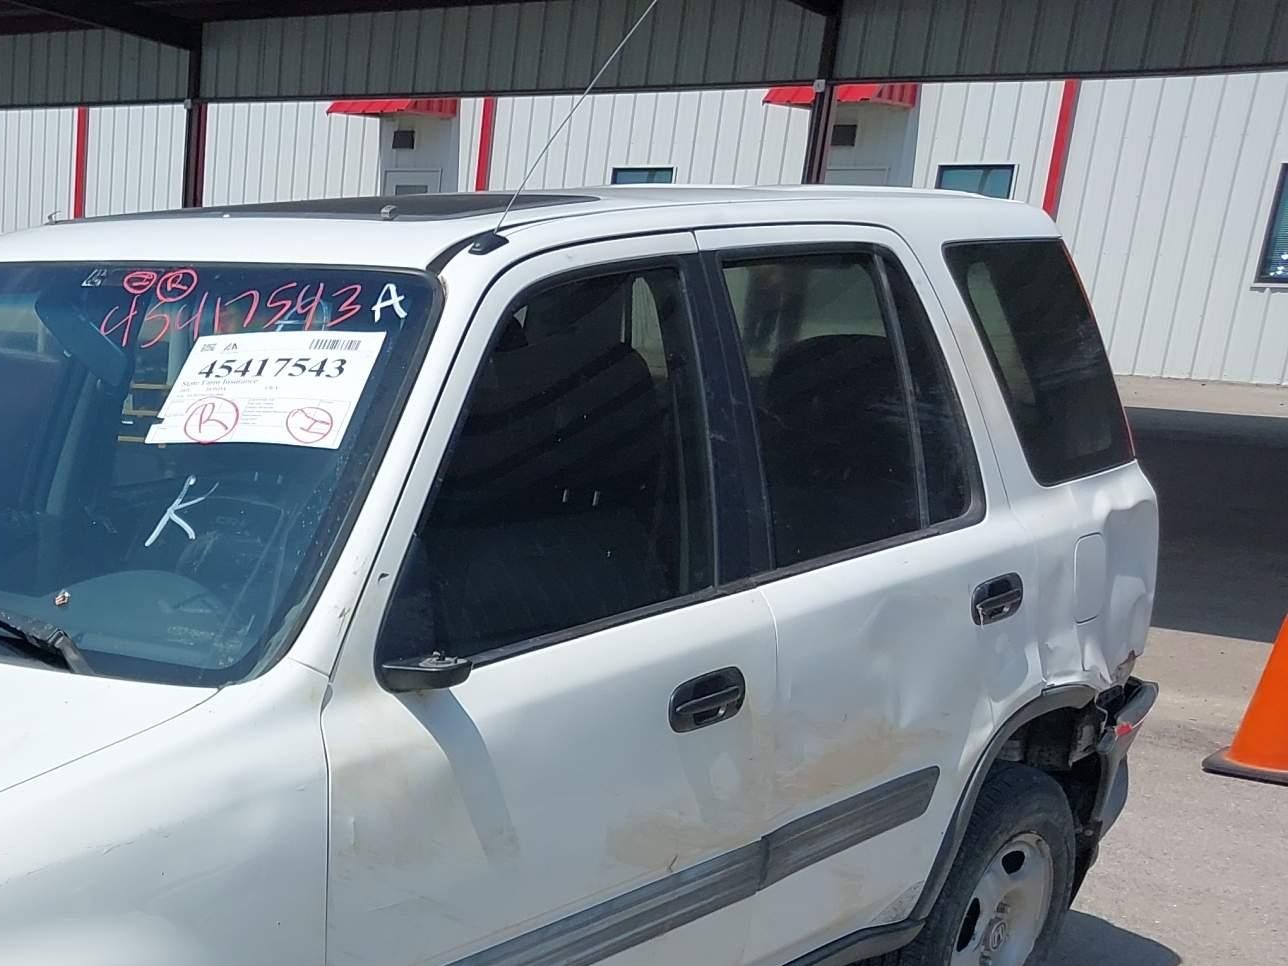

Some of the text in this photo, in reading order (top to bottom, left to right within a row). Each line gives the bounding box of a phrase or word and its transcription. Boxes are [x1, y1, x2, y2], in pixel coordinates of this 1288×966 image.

[100, 282, 362, 349] 45417543
[372, 283, 407, 323] A
[198, 357, 347, 378] 45417543
[144, 475, 220, 547] K
